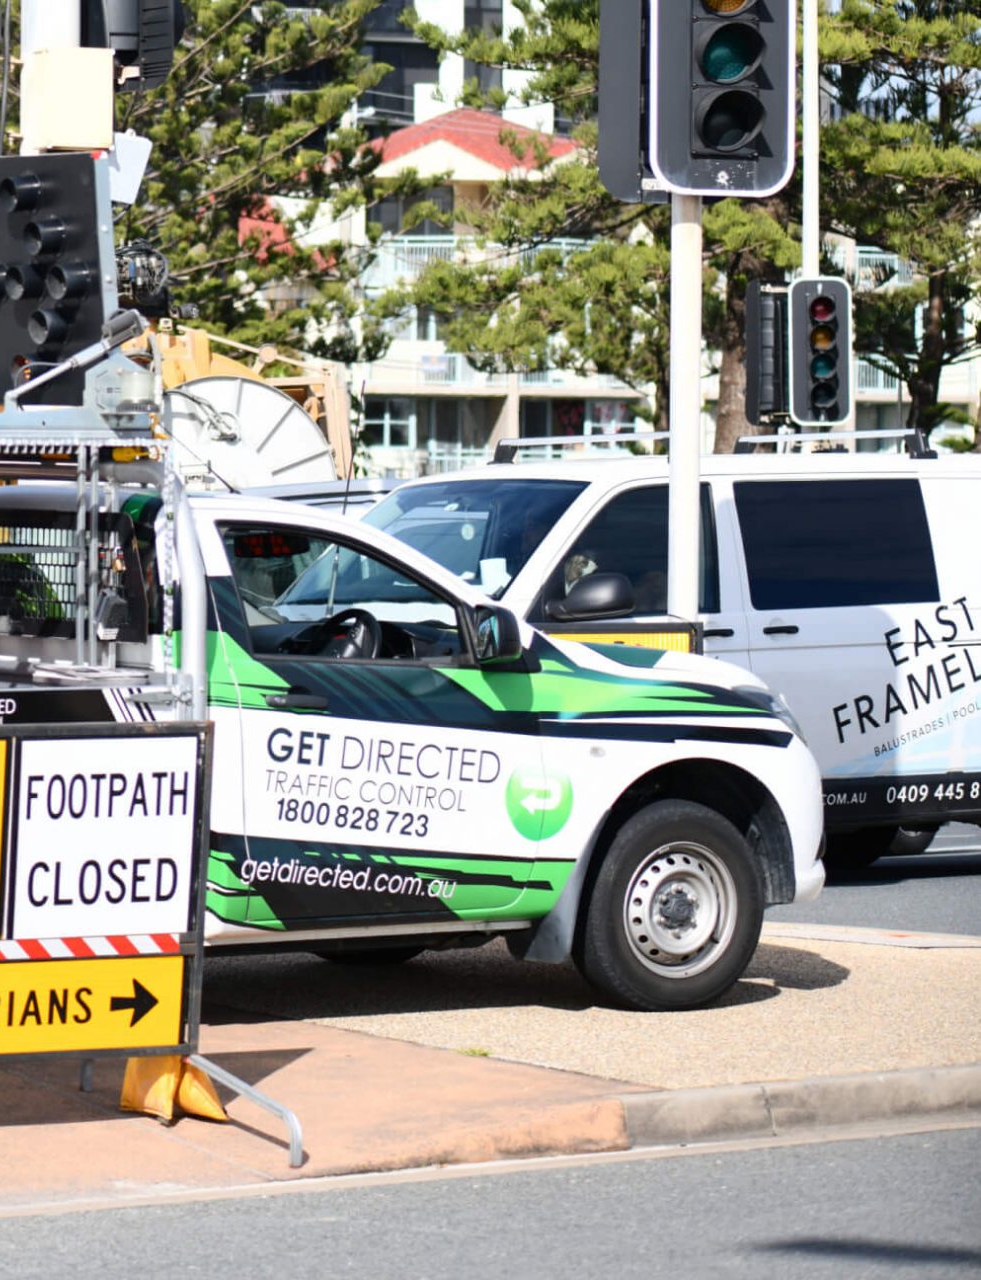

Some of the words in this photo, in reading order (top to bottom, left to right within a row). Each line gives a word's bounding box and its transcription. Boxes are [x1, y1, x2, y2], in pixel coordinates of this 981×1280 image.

[884, 596, 975, 666] EAST
[832, 648, 981, 744] FRAMEL
[267, 727, 330, 767] GET
[341, 735, 501, 784] DIRECTED
[873, 718, 944, 757] BALUSTRADES
[25, 770, 190, 820] FOOTPATH
[265, 769, 352, 800] TRAFFIC
[359, 780, 466, 812] CONTROL
[886, 785, 929, 803] 0409
[934, 782, 966, 800] 445
[277, 798, 330, 826] 1800
[335, 805, 380, 831] 828
[385, 810, 429, 837] 723
[27, 857, 179, 907] CLOSED
[240, 856, 458, 899] getdirected.com.au
